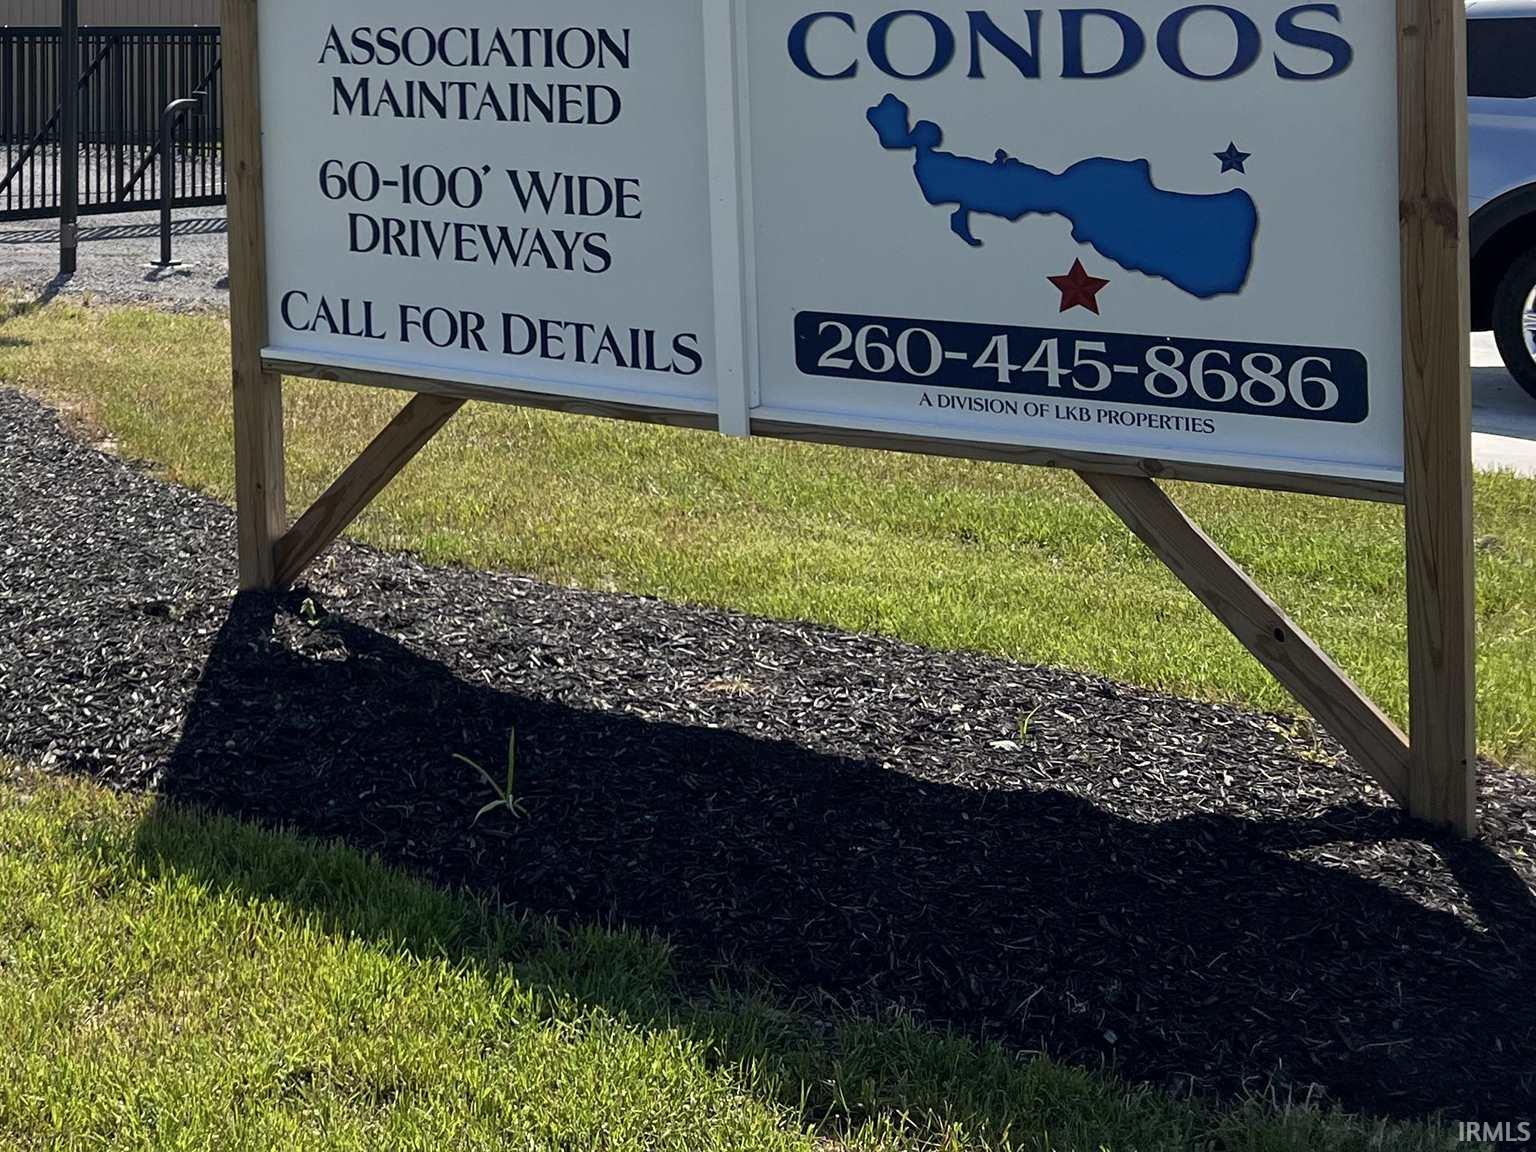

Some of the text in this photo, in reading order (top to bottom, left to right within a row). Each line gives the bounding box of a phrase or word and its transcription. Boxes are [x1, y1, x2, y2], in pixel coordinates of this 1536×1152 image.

[318, 23, 631, 70] ASSOCIATION
[787, 3, 1354, 82] CONDOS
[331, 76, 622, 125] MAINTAINED
[319, 159, 643, 220] 60-100' WIDE
[348, 212, 612, 274] DRIVEWAYS
[280, 290, 703, 376] CALL FOR DETAILS
[817, 321, 1339, 411] 260-445-8686
[919, 391, 1216, 434] A DIVISION OF LKB PROPERTIES
